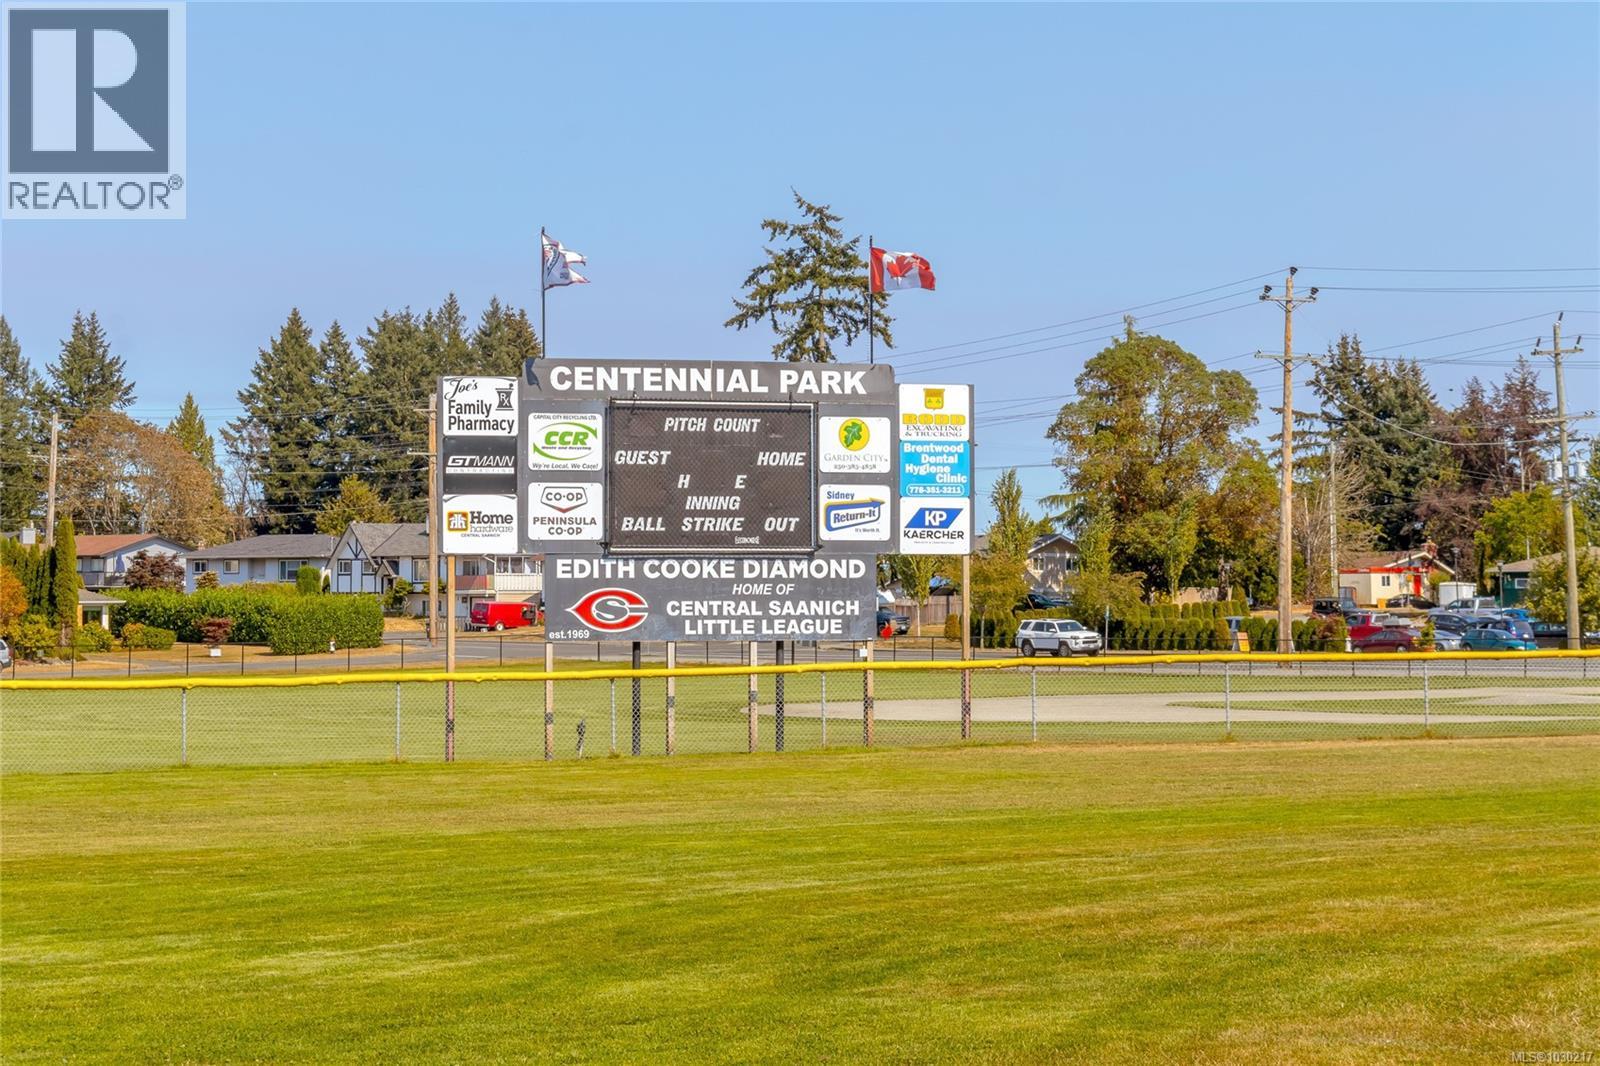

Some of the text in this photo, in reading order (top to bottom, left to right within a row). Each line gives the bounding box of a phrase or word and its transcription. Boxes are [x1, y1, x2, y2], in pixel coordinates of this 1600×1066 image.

[549, 366, 868, 395] CENTENNIAL PARK
[444, 378, 478, 400] Joe's
[448, 399, 492, 418] Family
[448, 415, 515, 434] Pharmacy
[664, 417, 761, 433] PITCH COUNT
[544, 430, 589, 446] CCR
[903, 442, 964, 453] Brentwood
[614, 450, 671, 465] GUEST
[757, 452, 806, 466] HOME
[921, 454, 958, 464] Dental
[905, 463, 951, 476] Hygiene
[677, 474, 691, 489] H
[735, 475, 747, 489] E
[935, 473, 968, 483] Clinic
[826, 490, 855, 500] Sidney
[685, 496, 741, 510] INNING
[469, 510, 514, 524] Home
[533, 516, 597, 525] PENINSULA
[833, 508, 876, 524] Return-It
[924, 510, 948, 526] KP
[470, 524, 514, 533] hardware
[621, 517, 800, 532] BALL STRIKE OUT
[903, 530, 965, 539] KAERCHER
[556, 558, 866, 579] EDITH COOKE DIAMOND
[732, 583, 795, 595] HOME OF
[666, 600, 859, 616] CENTRAL SAANICH
[548, 629, 590, 639] est.1969
[684, 619, 843, 635] LITTLE LEAGUE
